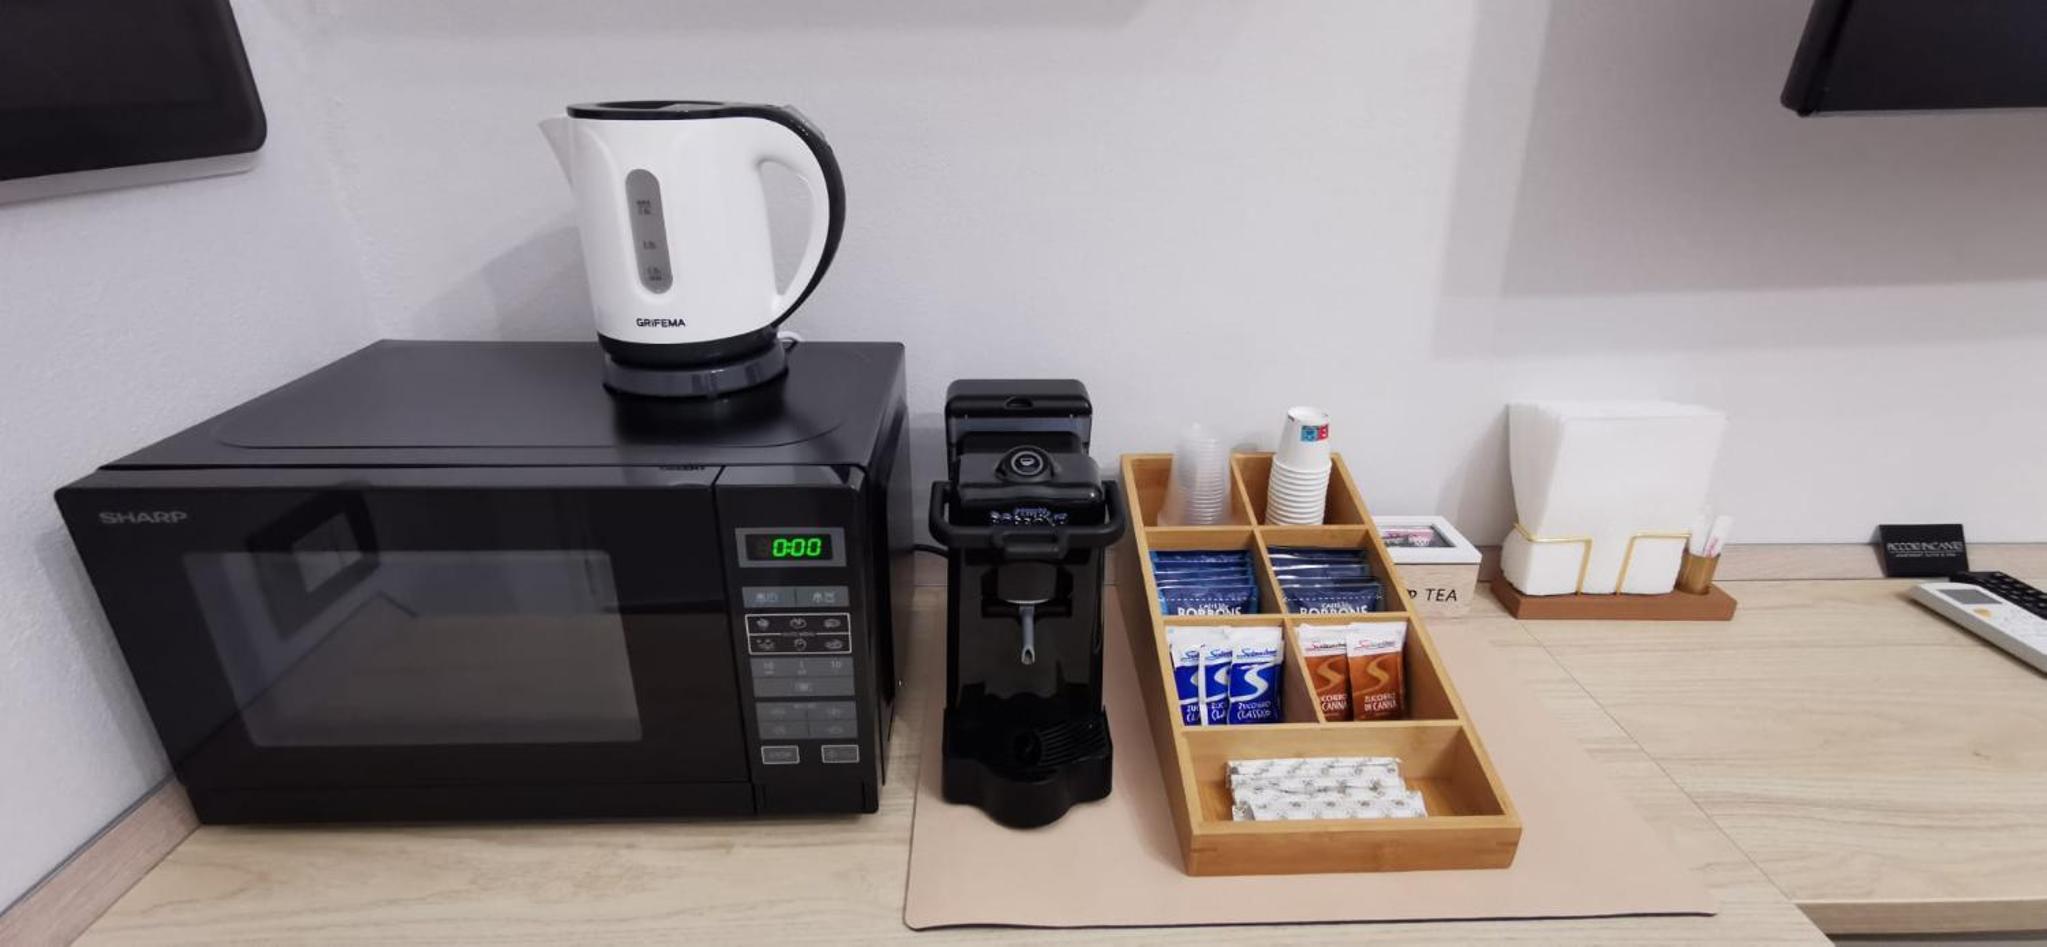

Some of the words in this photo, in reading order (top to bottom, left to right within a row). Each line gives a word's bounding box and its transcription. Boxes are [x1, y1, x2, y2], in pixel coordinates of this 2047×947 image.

[636, 318, 686, 327] GRIFEMA
[99, 511, 188, 524] SHARP
[772, 538, 822, 557] 0:00
[1425, 588, 1457, 602] TEA
